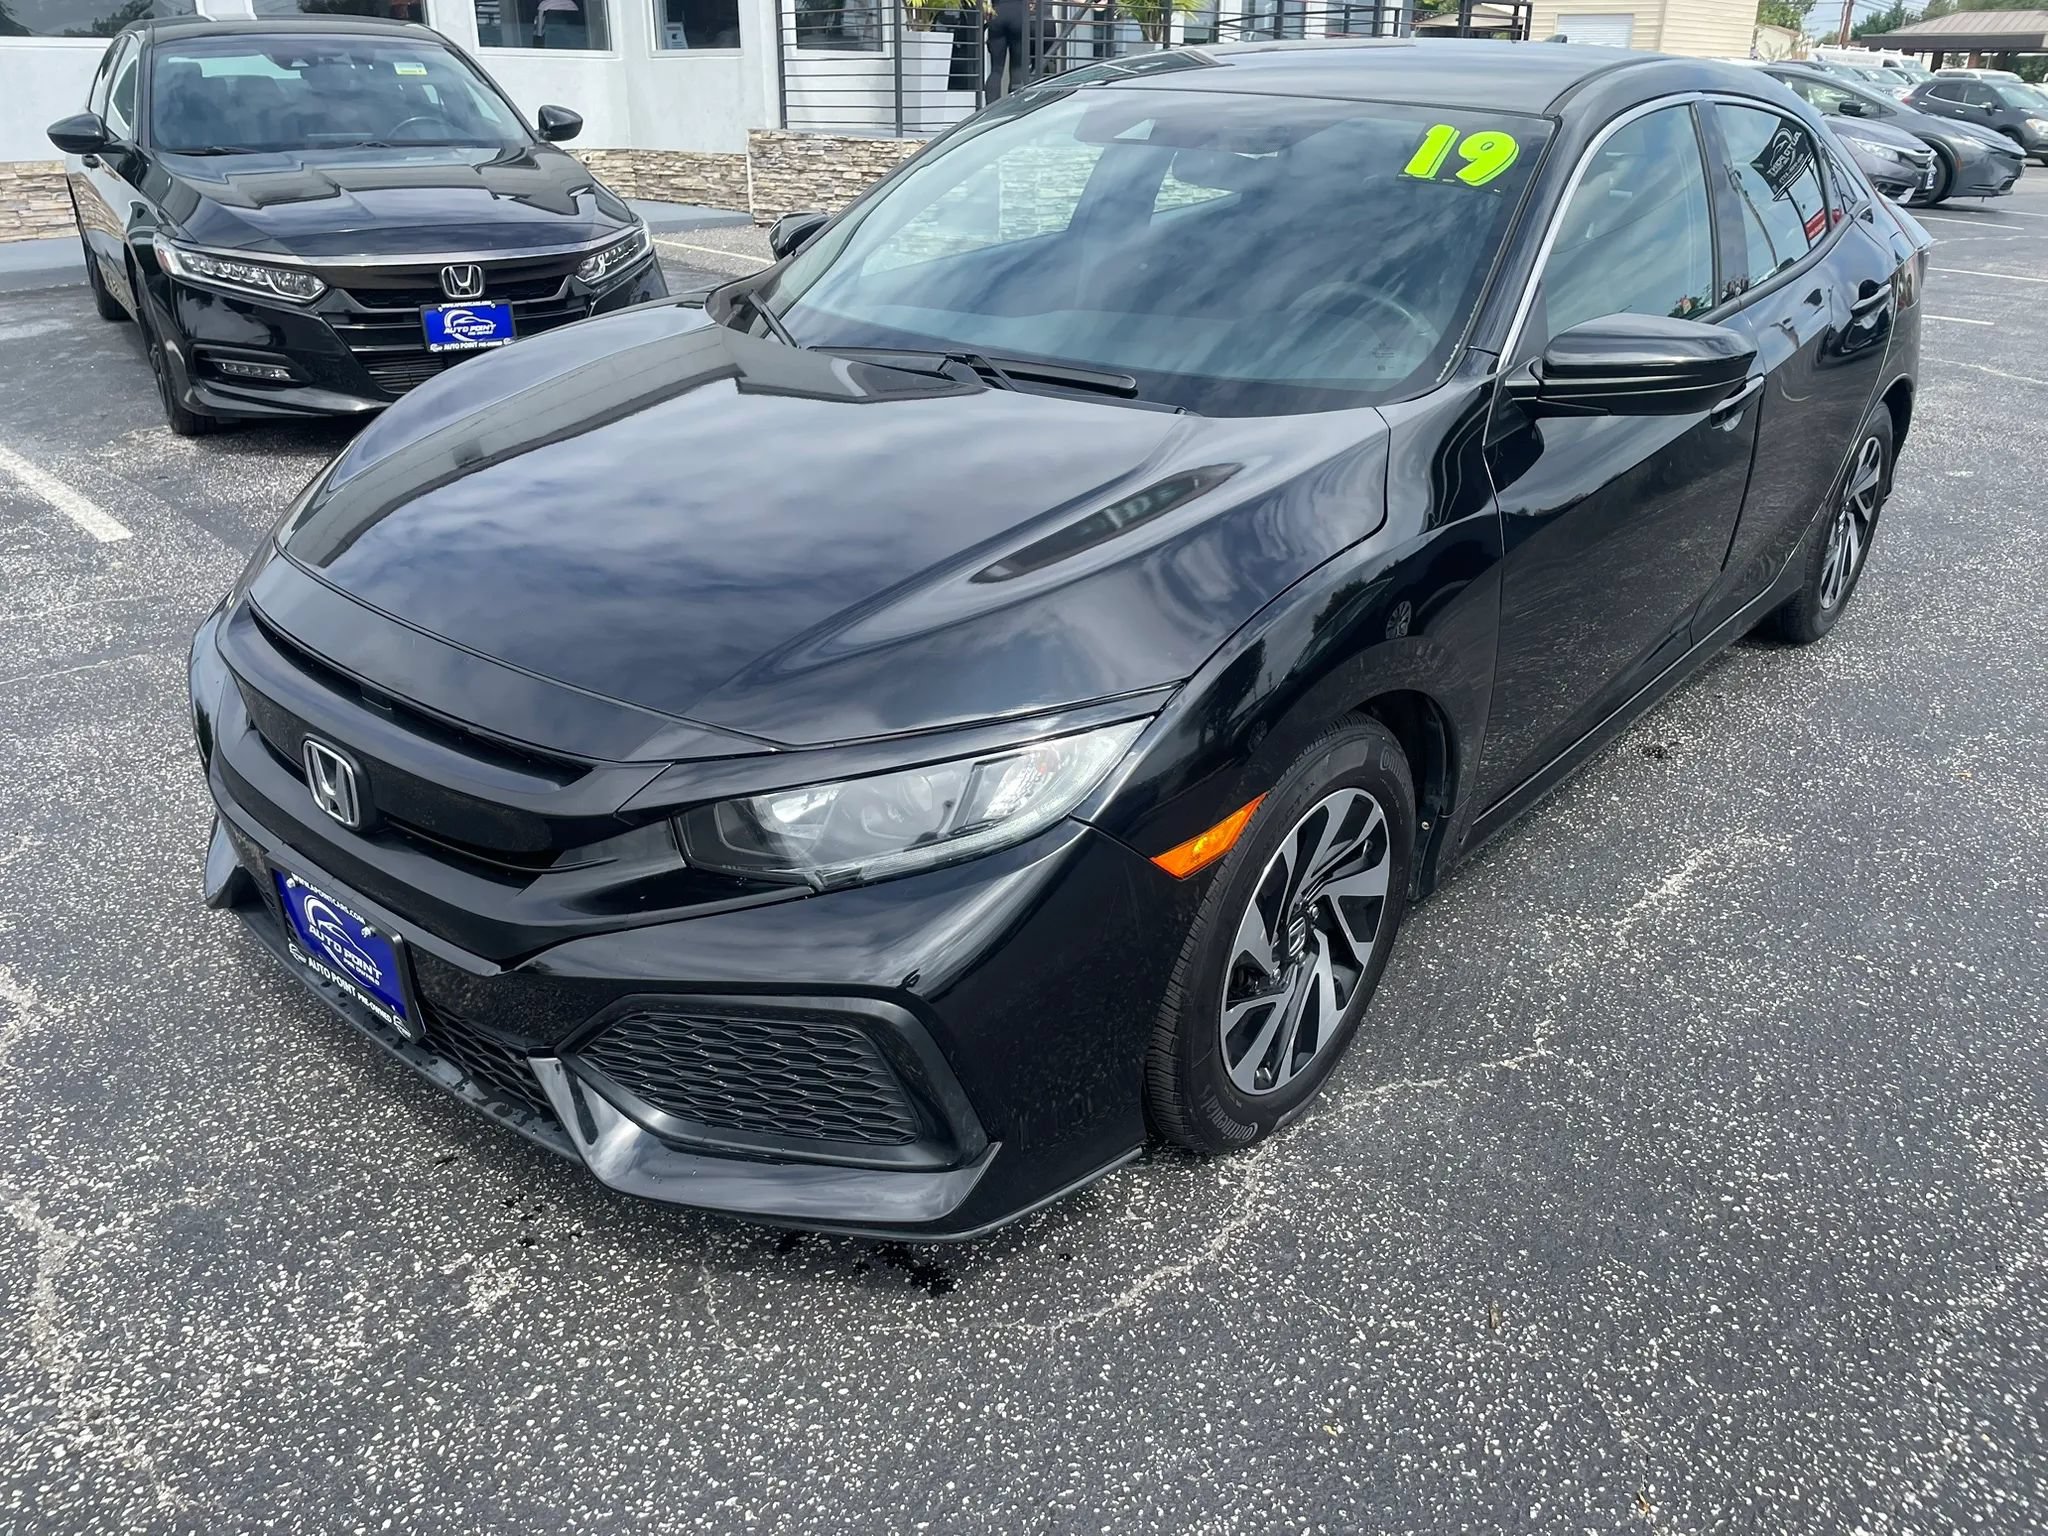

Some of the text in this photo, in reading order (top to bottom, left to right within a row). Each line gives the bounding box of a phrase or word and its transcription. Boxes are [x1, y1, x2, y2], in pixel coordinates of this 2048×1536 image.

[1404, 124, 1519, 186] 19
[308, 957, 331, 979] AUTO
[331, 971, 356, 997] POINT
[309, 924, 383, 980] AUTO POINT
[1200, 1094, 1258, 1143] Continental
